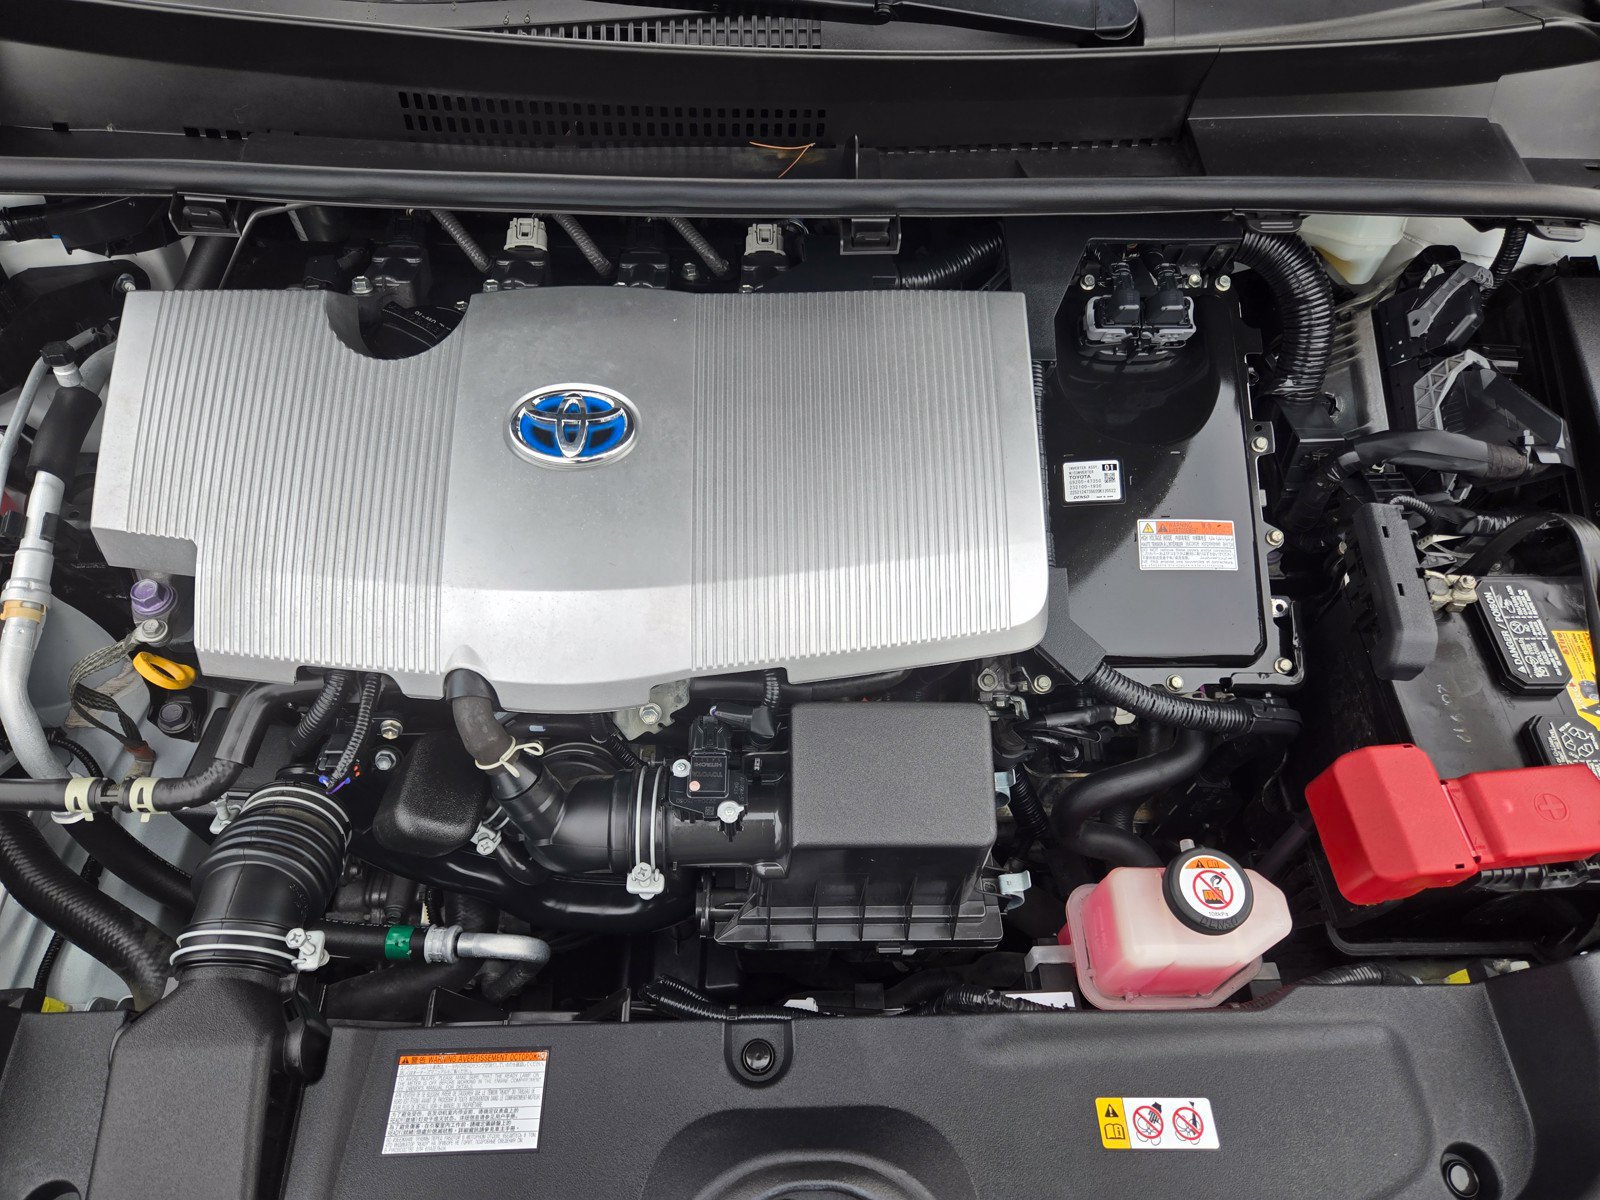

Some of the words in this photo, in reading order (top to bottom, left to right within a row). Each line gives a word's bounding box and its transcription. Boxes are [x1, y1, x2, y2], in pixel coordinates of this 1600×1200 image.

[1484, 592, 1504, 622] POISON
[1500, 630, 1523, 665] DANGER
[459, 1052, 508, 1062] AVERTISSEMENT
